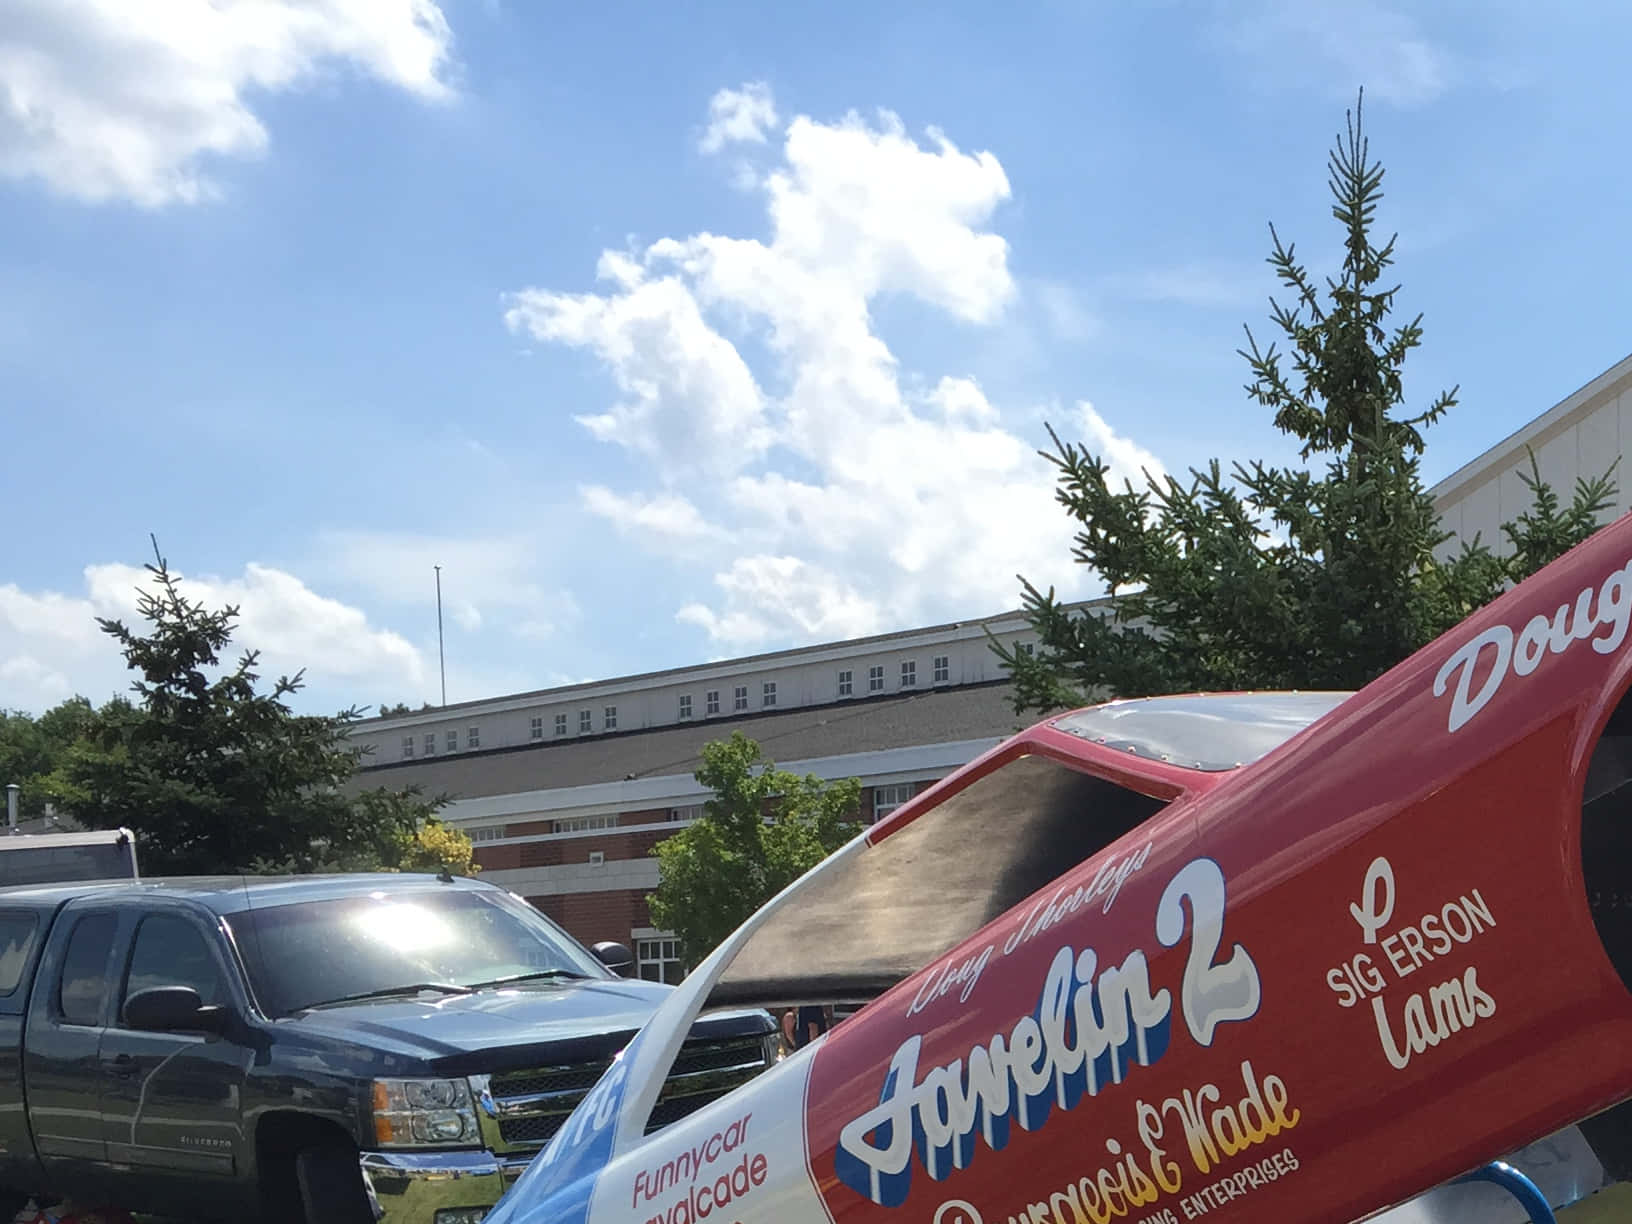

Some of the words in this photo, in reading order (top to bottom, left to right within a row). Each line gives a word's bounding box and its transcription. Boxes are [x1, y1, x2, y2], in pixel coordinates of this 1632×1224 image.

[1326, 952, 1387, 1007] SIG
[1381, 888, 1497, 978] ERSON
[835, 945, 1172, 1207] Javelin
[1156, 857, 1261, 1047] 2
[632, 1111, 752, 1209] Funnycar
[1162, 1060, 1301, 1174] Wade
[1183, 1147, 1300, 1221] ENTERPRISES
